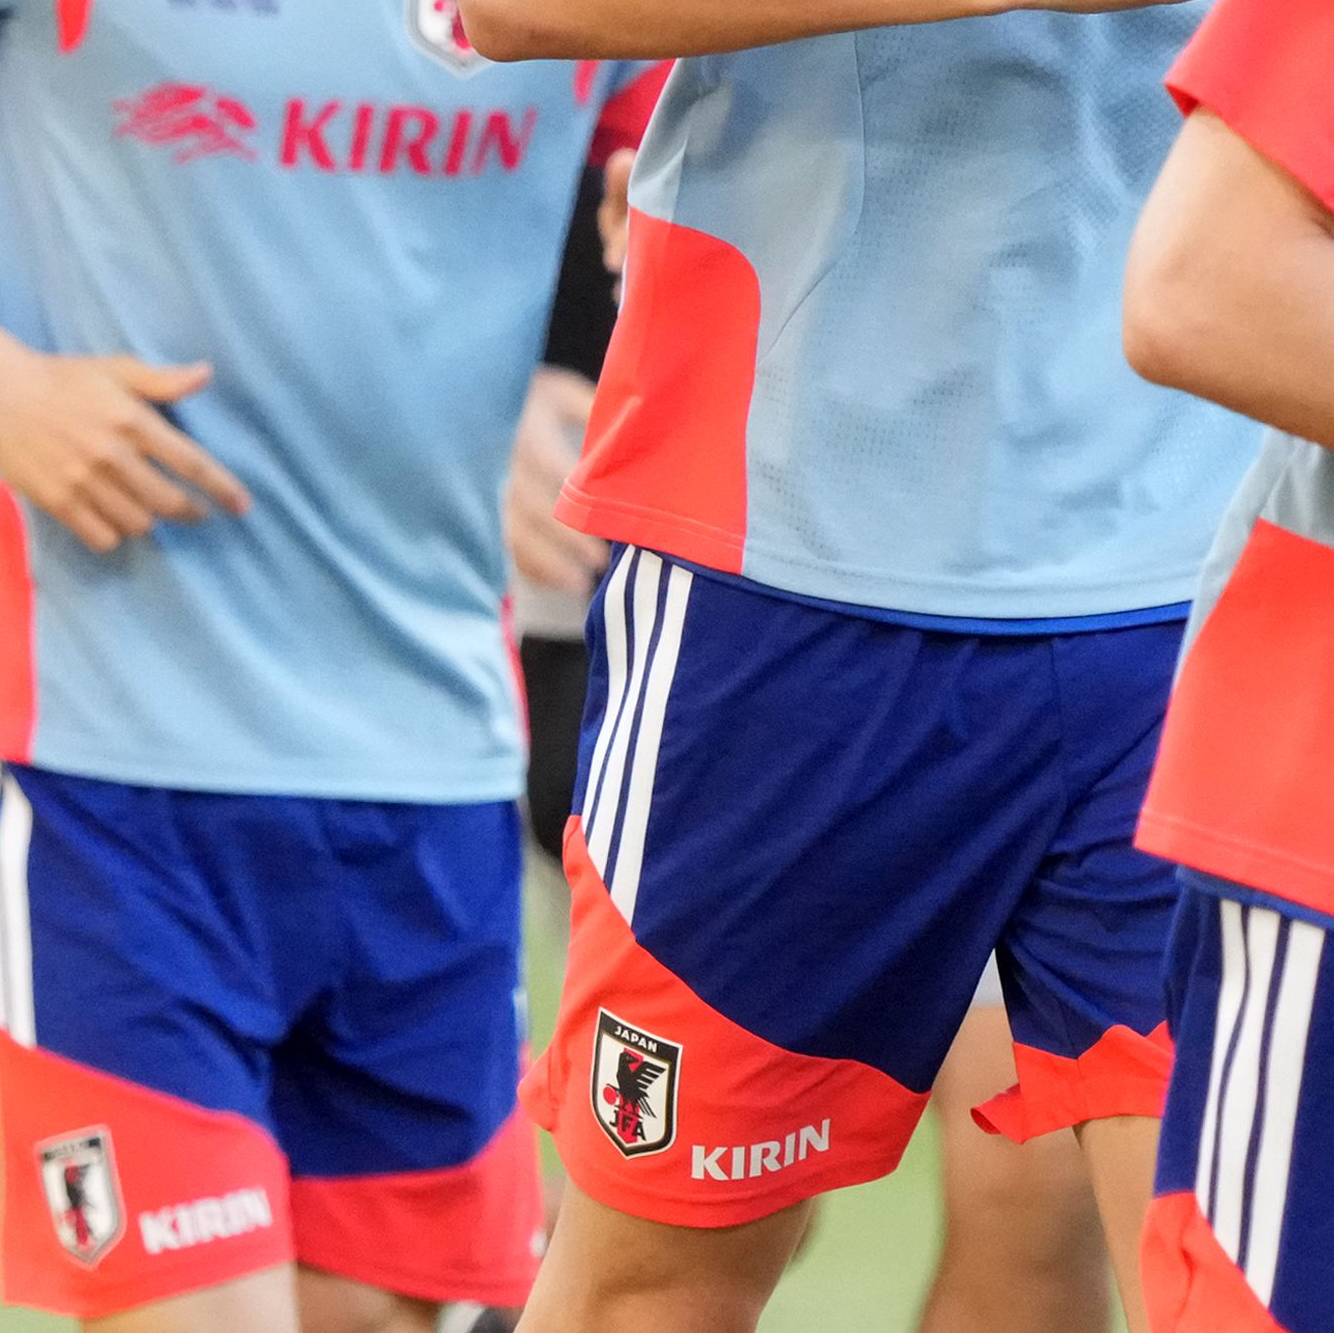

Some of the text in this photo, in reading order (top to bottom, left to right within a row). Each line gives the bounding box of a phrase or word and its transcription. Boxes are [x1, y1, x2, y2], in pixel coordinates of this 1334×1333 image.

[279, 97, 538, 177] KIRIN
[614, 1025, 658, 1053] JAPAN
[609, 1110, 647, 1141] JFA
[691, 1118, 831, 1181] KIRIN
